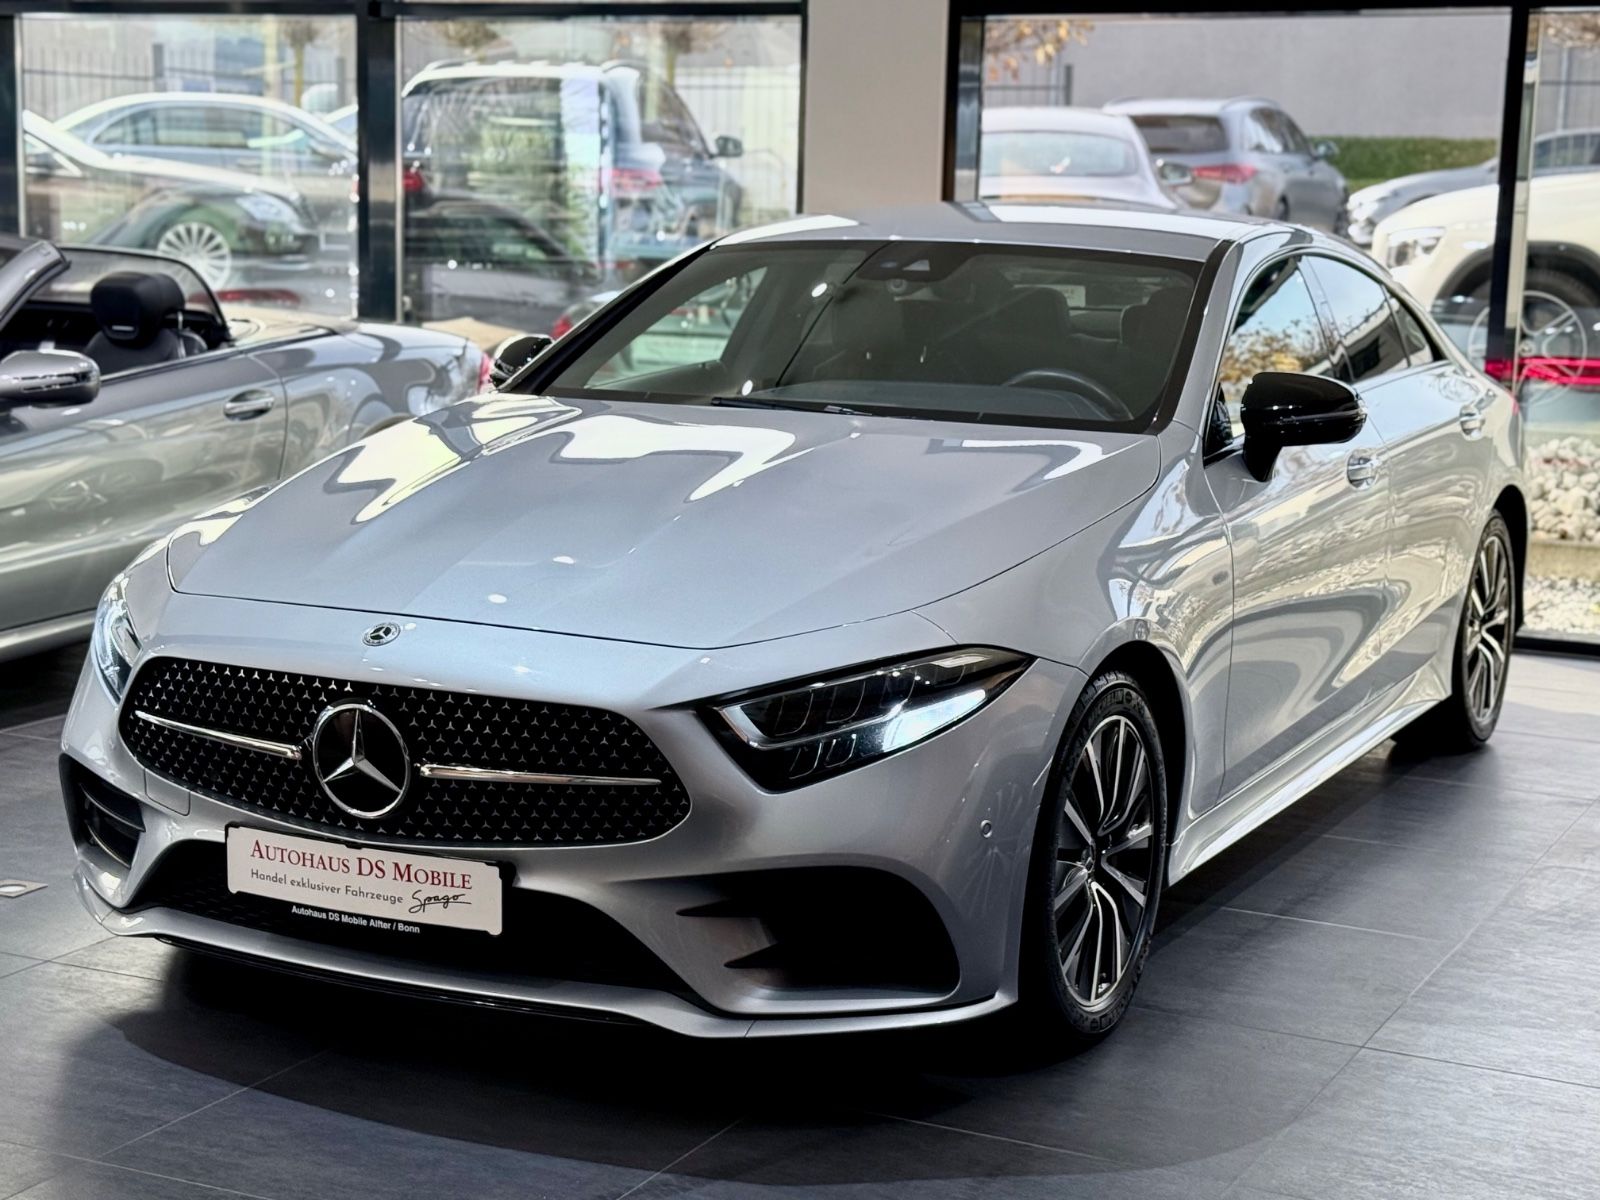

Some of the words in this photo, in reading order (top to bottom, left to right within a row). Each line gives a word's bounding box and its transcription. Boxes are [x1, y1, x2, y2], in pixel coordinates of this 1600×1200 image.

[250, 839, 350, 874] AUTOHAUS
[356, 857, 386, 879] DS
[392, 862, 472, 890] MOBILE
[251, 868, 287, 885] Handel
[290, 877, 341, 895] exklusiver
[345, 885, 404, 905] Fahrzeuge
[291, 905, 327, 920] Autohaus
[328, 911, 340, 922] DS
[341, 914, 368, 927] Mobile
[397, 923, 420, 934] Bonn
